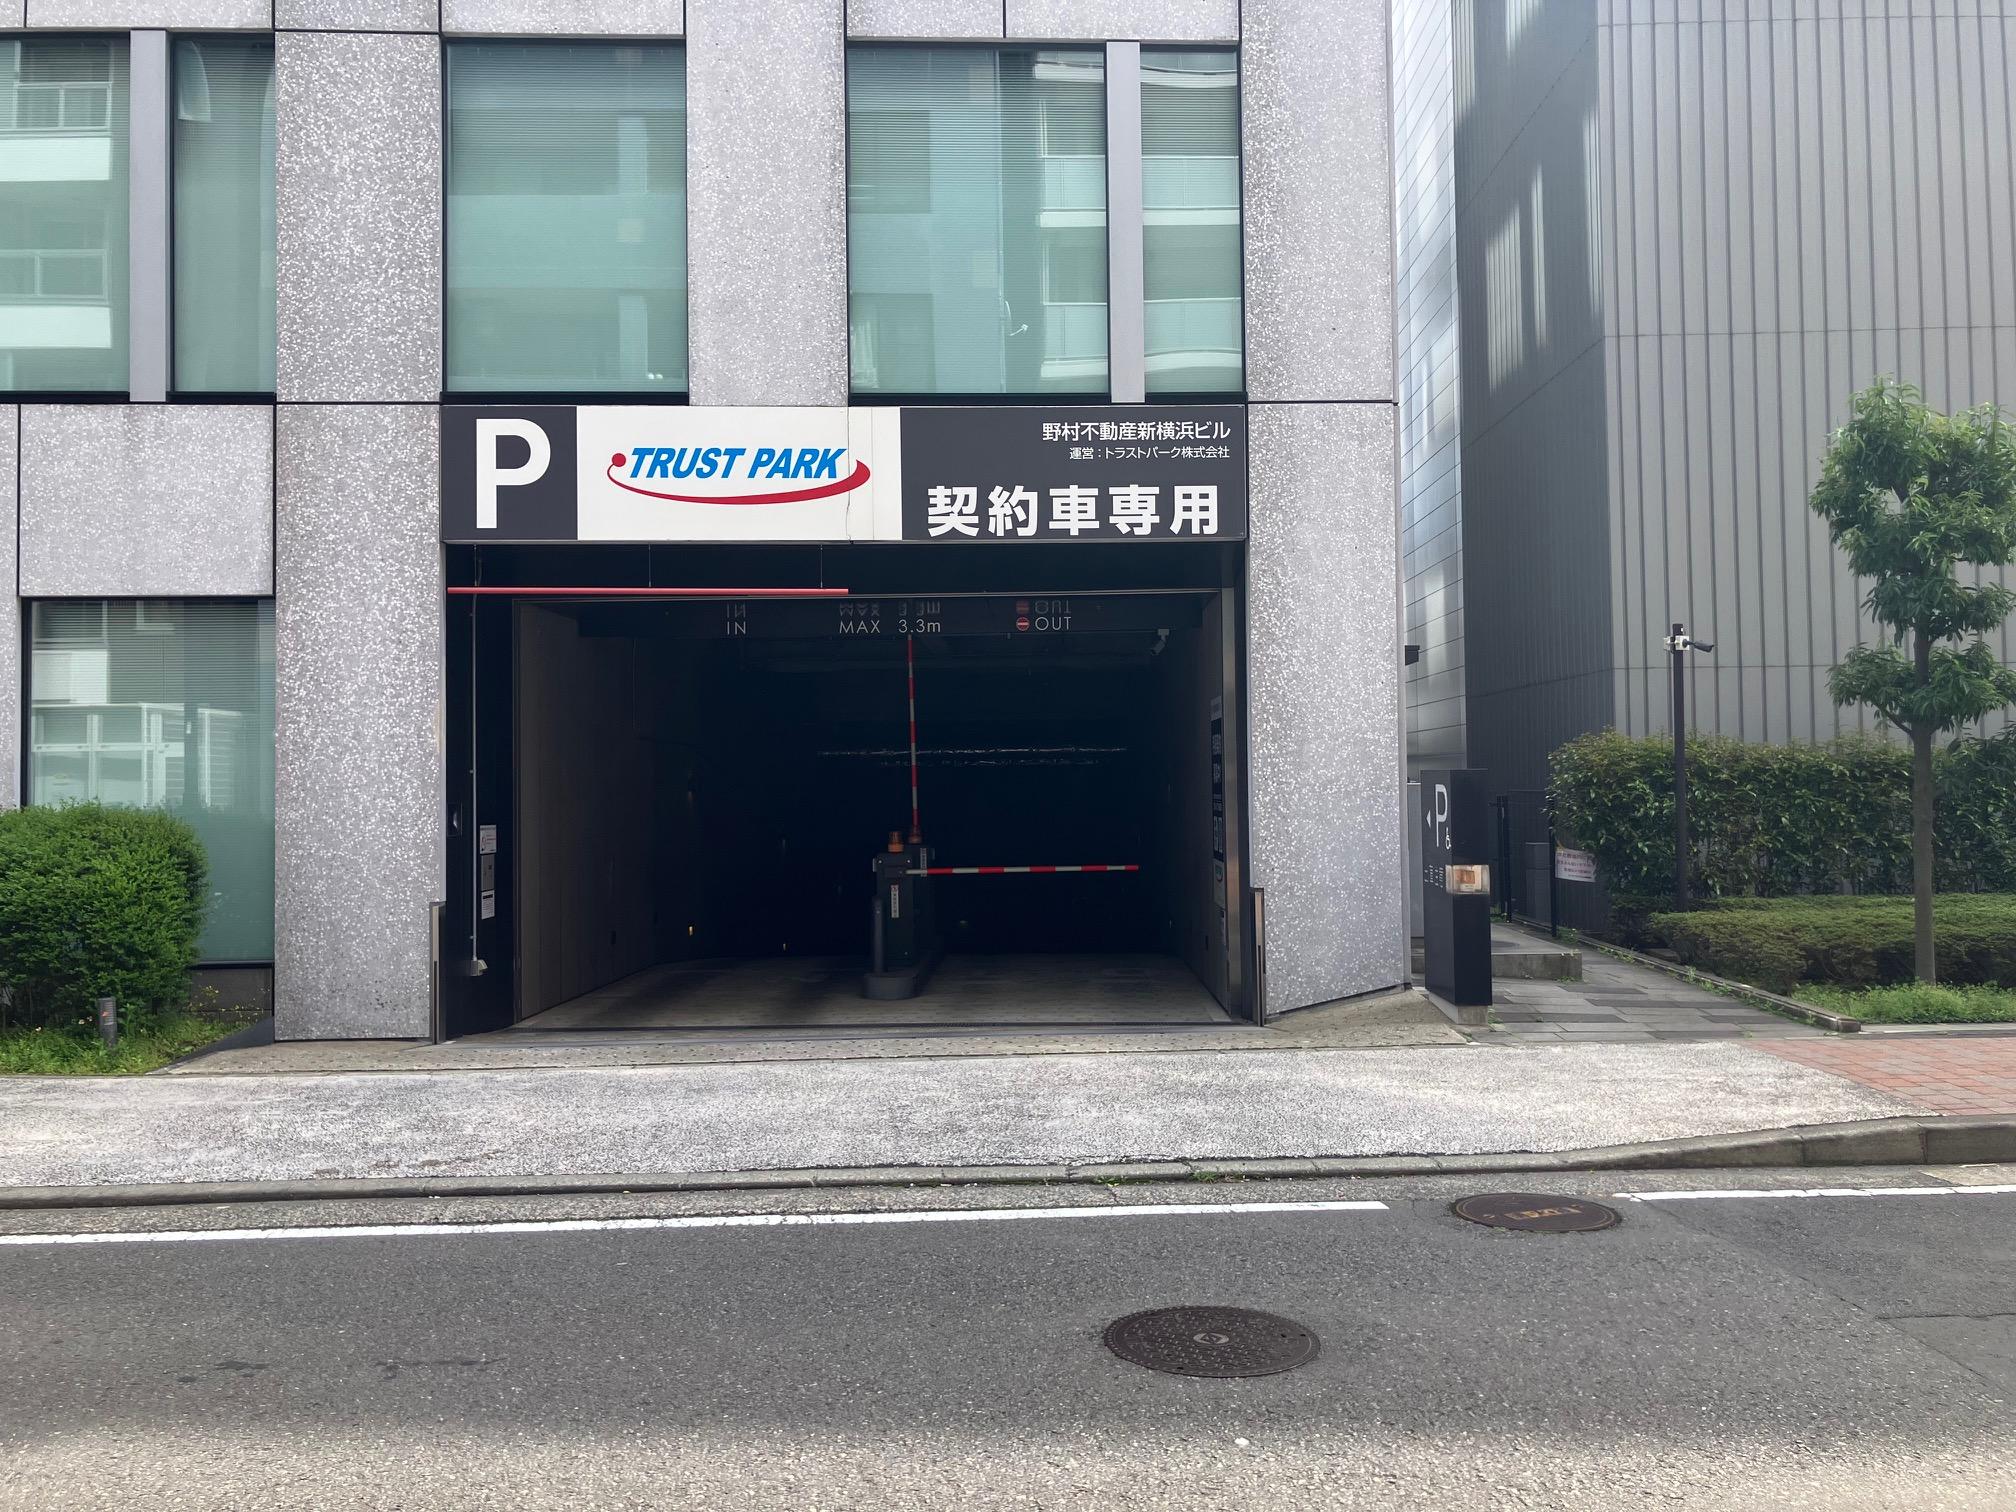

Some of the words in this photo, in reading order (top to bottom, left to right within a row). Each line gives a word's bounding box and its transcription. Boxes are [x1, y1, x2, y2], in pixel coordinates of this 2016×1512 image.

[1042, 421, 1231, 442] 野村不動産新横浜ビル
[476, 418, 551, 529] P
[629, 446, 745, 479] TRUST
[748, 447, 847, 479] PARK
[927, 484, 1219, 537] 契約車専用
[726, 621, 746, 635] IN
[839, 619, 881, 634] MAX
[898, 618, 942, 633] 3.3m
[1034, 616, 1072, 631] OUT
[1435, 784, 1448, 848] P
